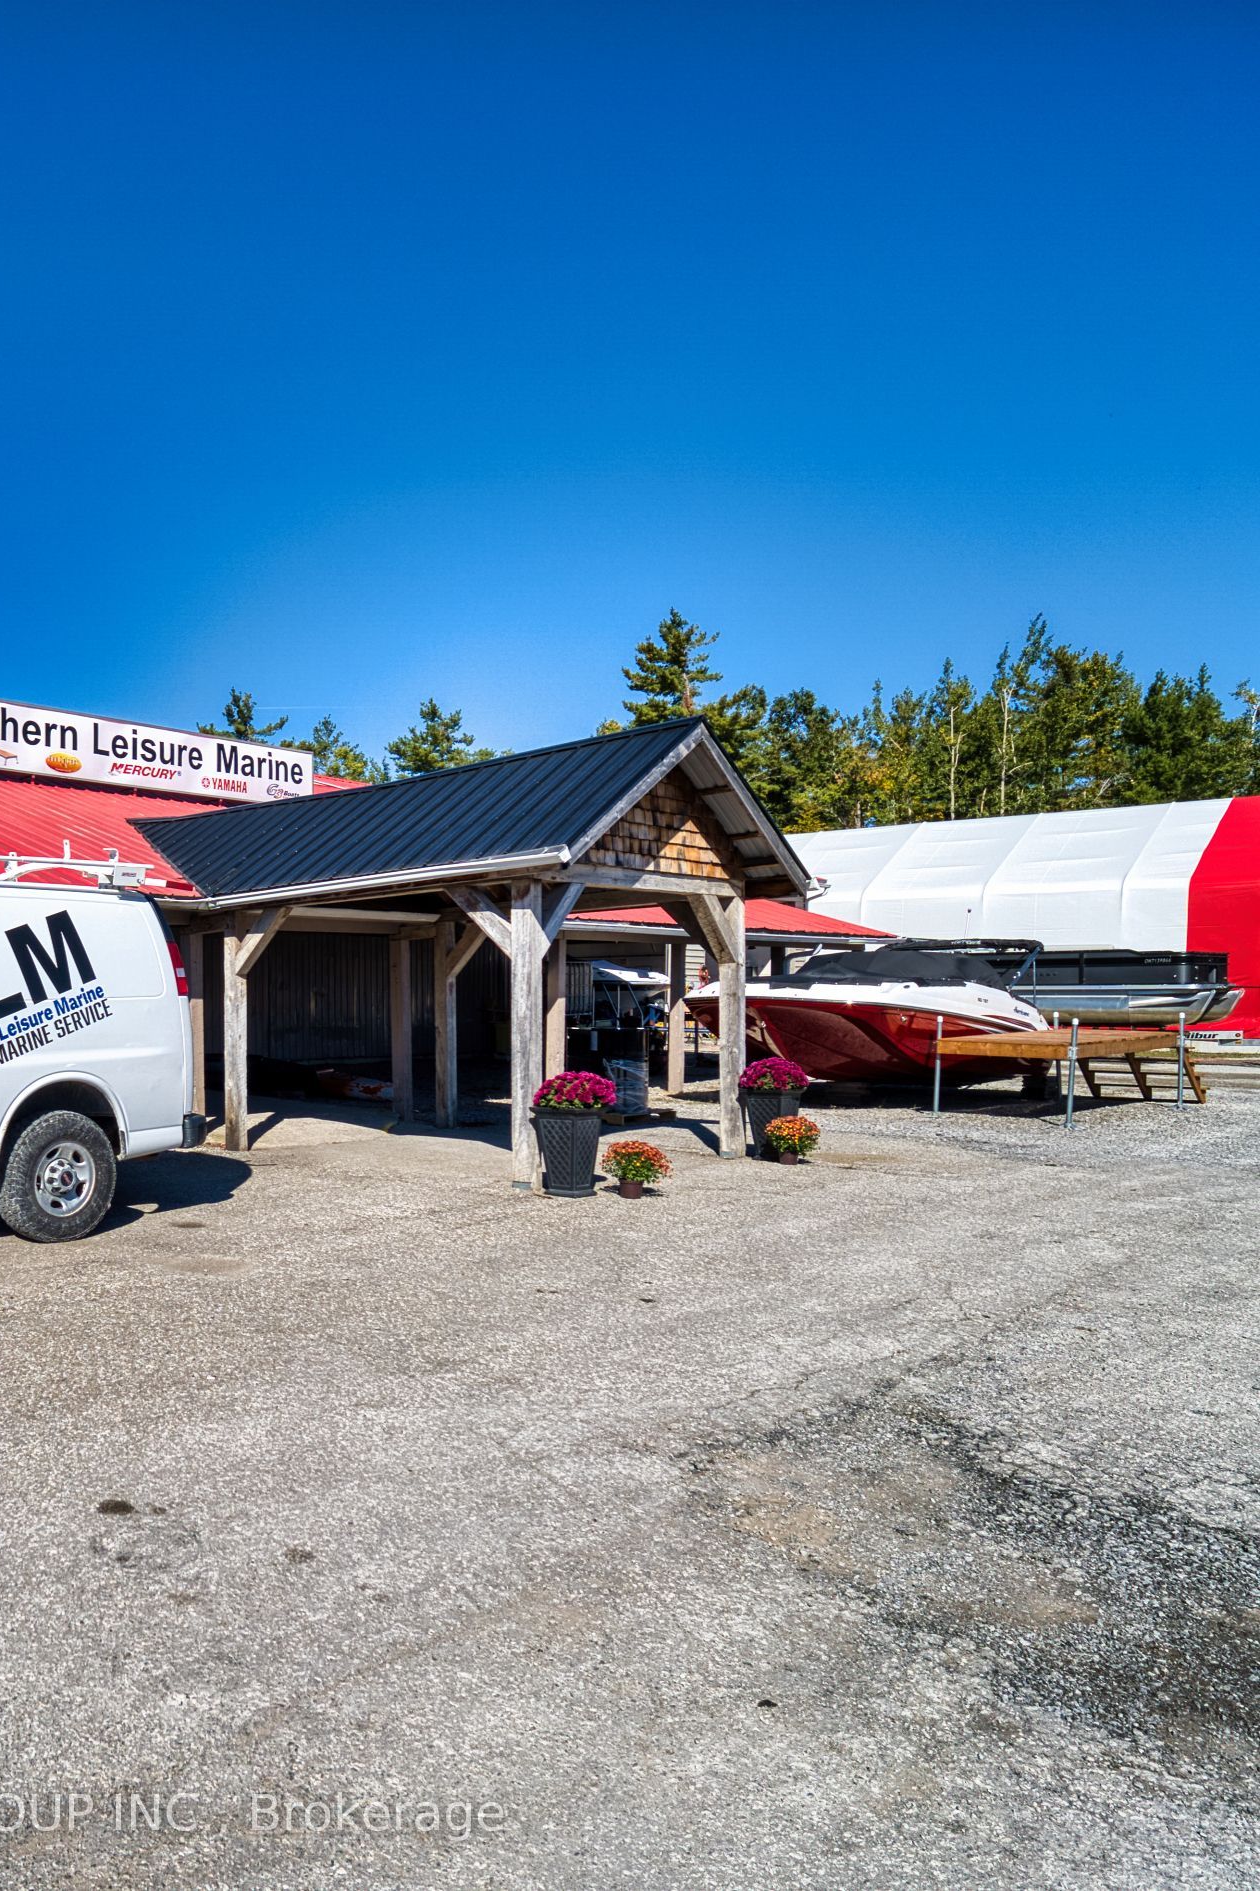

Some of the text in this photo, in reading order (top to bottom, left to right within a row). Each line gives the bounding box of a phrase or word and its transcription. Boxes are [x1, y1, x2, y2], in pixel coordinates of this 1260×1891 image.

[93, 722, 204, 771] Leisure
[216, 742, 304, 785] Marine
[110, 763, 177, 780] MERCURY
[212, 777, 248, 794] YAMAHA
[53, 985, 106, 1016] Marine
[54, 998, 114, 1038] SERVICE
